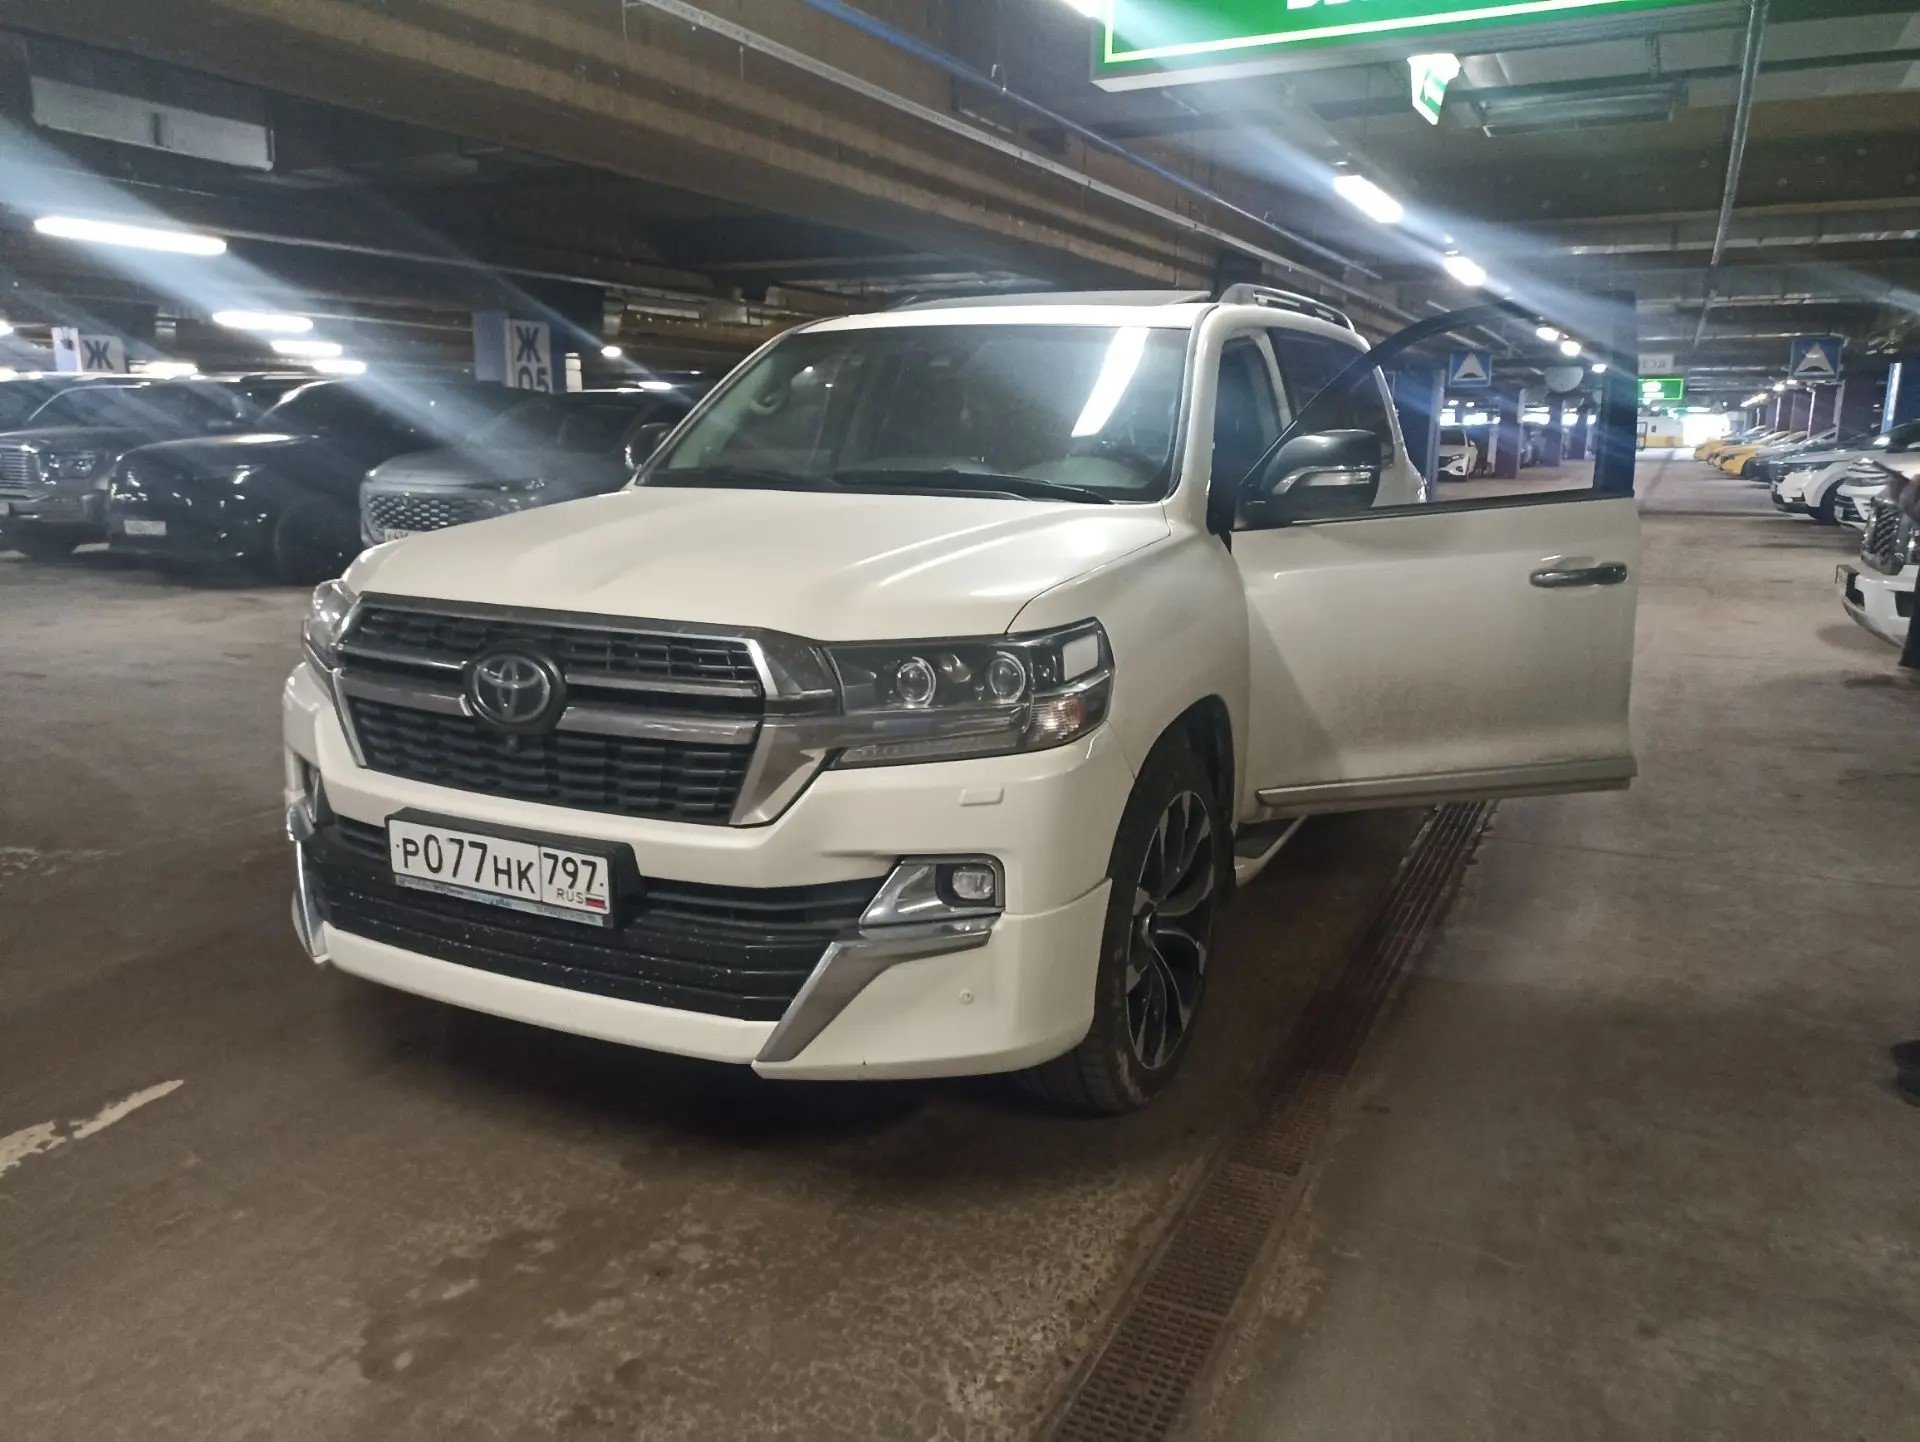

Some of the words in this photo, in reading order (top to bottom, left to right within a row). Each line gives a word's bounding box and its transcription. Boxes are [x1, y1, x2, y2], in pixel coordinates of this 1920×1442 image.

[84, 339, 114, 370] Ж
[516, 325, 541, 362] Ж
[543, 852, 597, 892] 797
[556, 888, 585, 905] RUS
